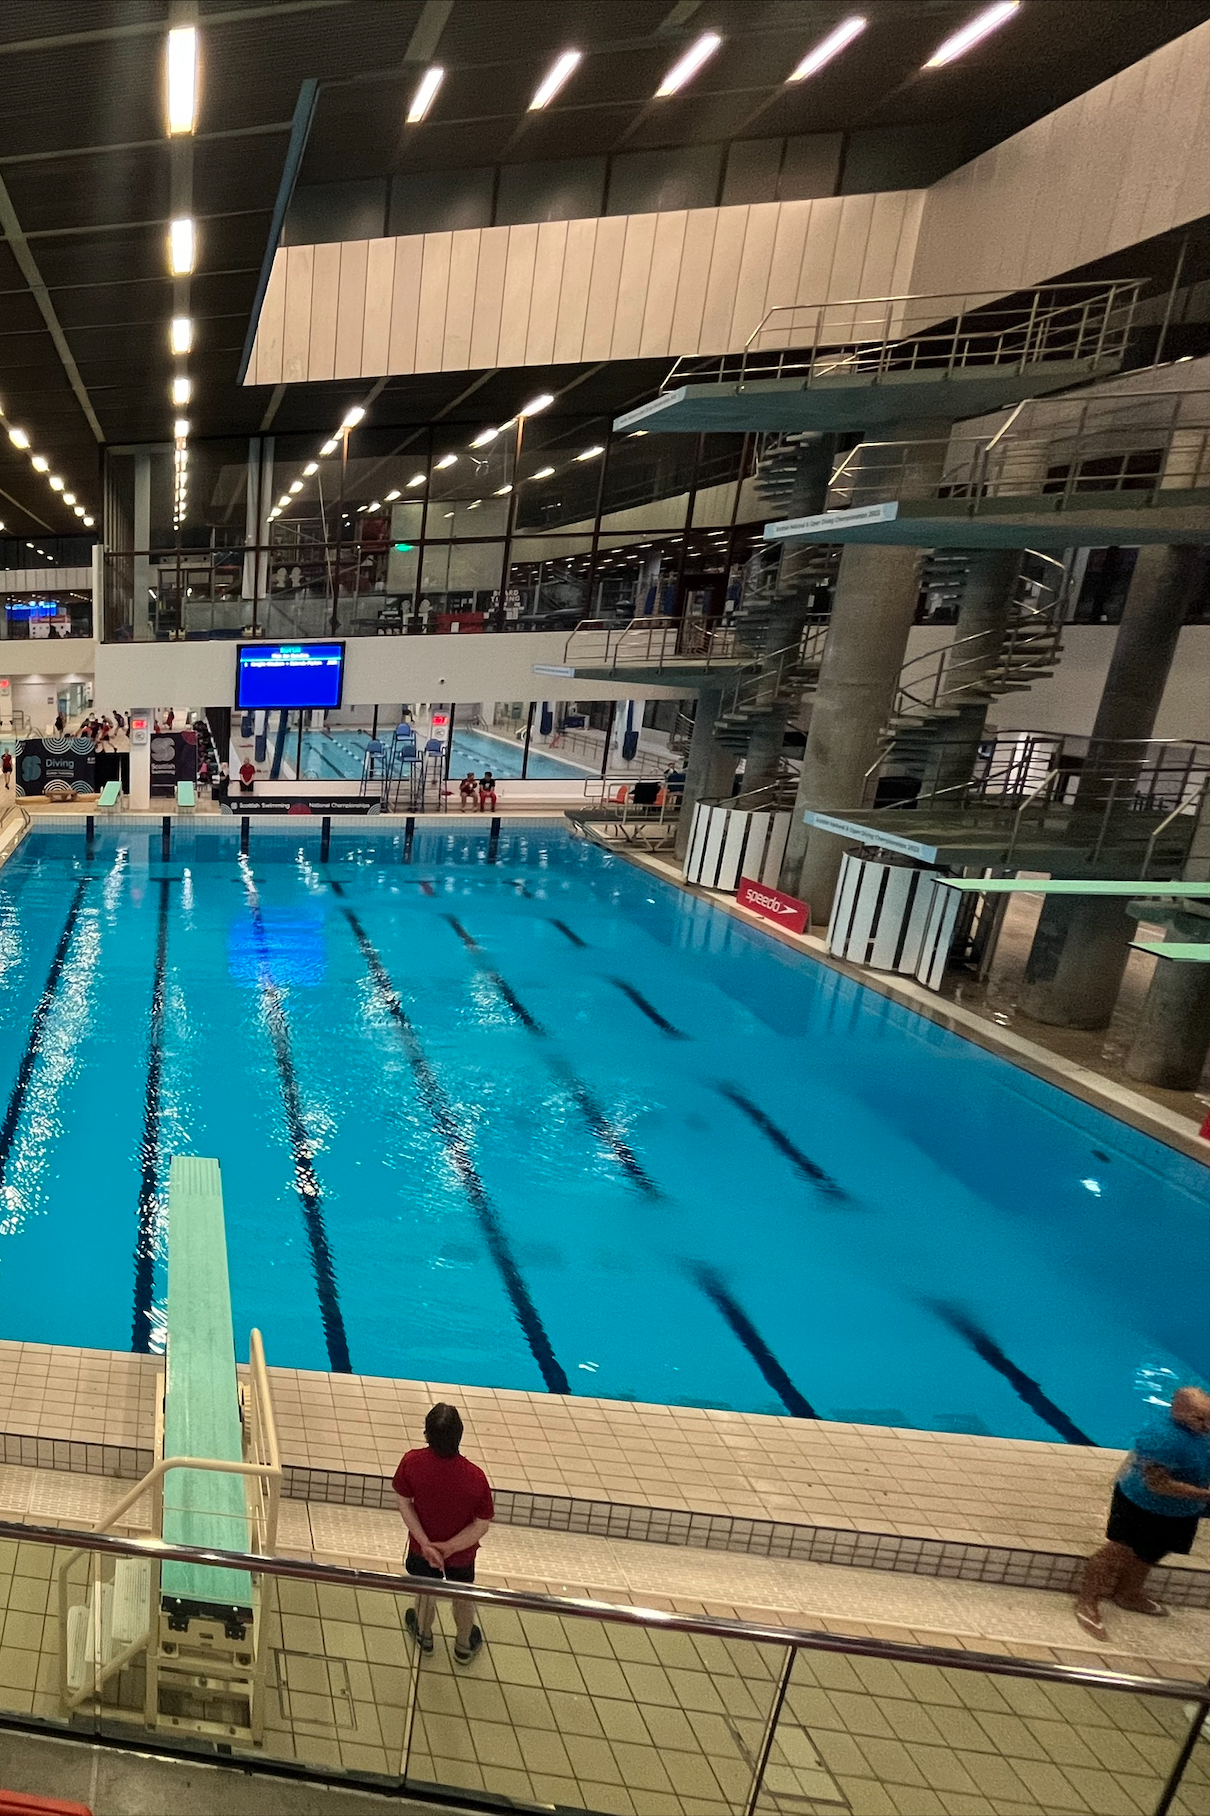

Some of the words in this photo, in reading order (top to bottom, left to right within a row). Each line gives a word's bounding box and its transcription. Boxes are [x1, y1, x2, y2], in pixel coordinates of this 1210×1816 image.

[45, 758, 74, 769] Diving
[331, 802, 370, 810] Championships
[745, 888, 780, 912] speedo
